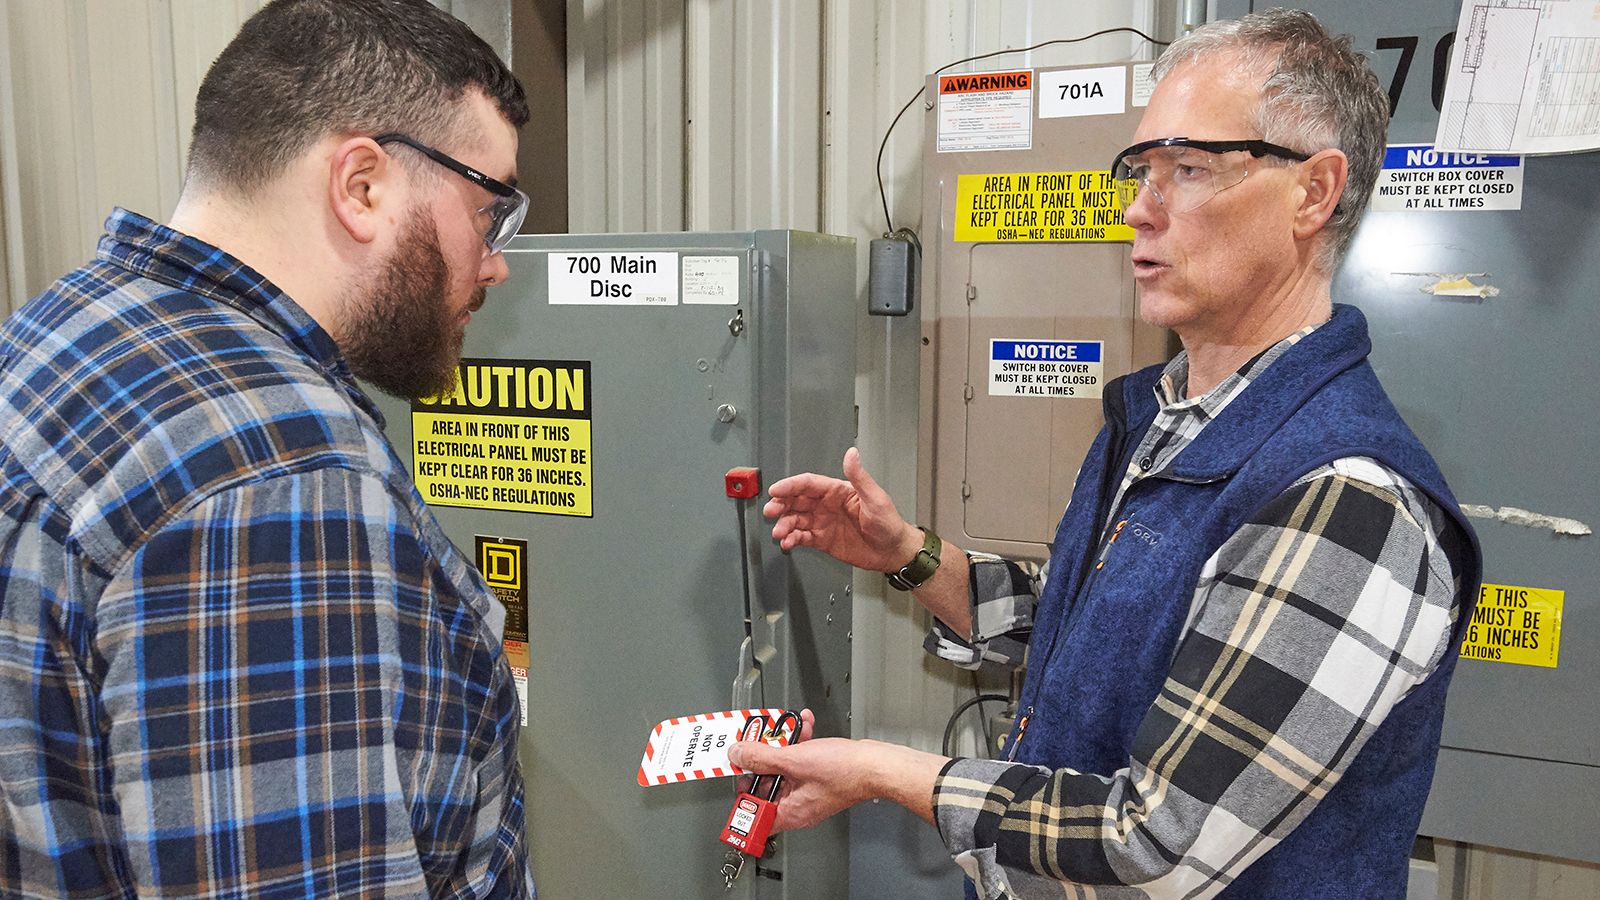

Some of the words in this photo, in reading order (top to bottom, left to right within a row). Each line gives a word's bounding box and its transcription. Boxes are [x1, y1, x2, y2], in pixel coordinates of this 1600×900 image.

[956, 74, 1028, 91] WARNING
[1058, 82, 1104, 100] 701A
[1406, 149, 1490, 166] NOTICE
[983, 176, 1012, 192] AREA
[1018, 176, 1030, 192] IN
[1036, 174, 1073, 191] FRONT
[1079, 174, 1093, 190] OF
[1390, 172, 1434, 183] SWITCH
[1438, 171, 1461, 181] BOX
[1465, 170, 1505, 181] COVER
[1379, 185, 1411, 195] MUST
[1415, 185, 1430, 195] BE
[1434, 184, 1465, 195] KEPT
[1468, 183, 1514, 194] CLOSED
[972, 193, 1035, 210] ELECTRICAL
[1041, 192, 1075, 209] PANEL
[1082, 191, 1115, 208] MUST
[1405, 198, 1420, 208] AT
[1424, 198, 1444, 208] ALL
[1448, 197, 1484, 208] TIMES
[971, 211, 998, 228] KEPT
[1004, 210, 1037, 227] CLEAR
[1044, 210, 1065, 226] FOR
[1071, 209, 1086, 225] 36
[1049, 227, 1106, 239] REGULATIONS
[566, 256, 602, 274] 700
[610, 255, 657, 274] Main
[590, 279, 633, 298] Disc
[1014, 344, 1077, 359] NOTICE
[1002, 362, 1036, 372] SWITCH
[1039, 363, 1056, 373] BOX
[1059, 364, 1089, 373] COVER
[419, 365, 584, 411] AUTION
[994, 374, 1019, 383] MUST
[1022, 374, 1033, 383] BE
[1036, 375, 1060, 384] KEPT
[1062, 375, 1097, 385] CLOSED
[1015, 385, 1026, 394] AT
[1029, 385, 1044, 394] ALL
[1047, 386, 1075, 395] TIMES
[431, 420, 462, 436] AREA
[466, 422, 478, 438] IN
[482, 422, 520, 439] FRONT
[523, 424, 538, 440] OF
[542, 425, 570, 442] THIS
[417, 440, 486, 459] ELECTRICAL
[489, 444, 528, 461] PANEL
[532, 446, 567, 464] MUST
[570, 448, 587, 465] BE
[419, 461, 448, 478] KEPT
[451, 463, 488, 480] CLEAR
[491, 465, 514, 482] FOR
[517, 467, 532, 483] 36
[536, 468, 586, 487] INCHES.
[429, 482, 489, 501] OSHA-NEC
[492, 487, 576, 508] REGULATIONS
[491, 587, 519, 597] AFETY
[1480, 587, 1488, 605] F
[1495, 588, 1528, 608] THIS
[1473, 606, 1515, 627] MUST
[1523, 611, 1541, 630] BE
[1487, 627, 1539, 650] INCHES
[682, 725, 703, 768] OPERATE
[700, 733, 713, 753] NOT
[715, 734, 728, 748] DO
